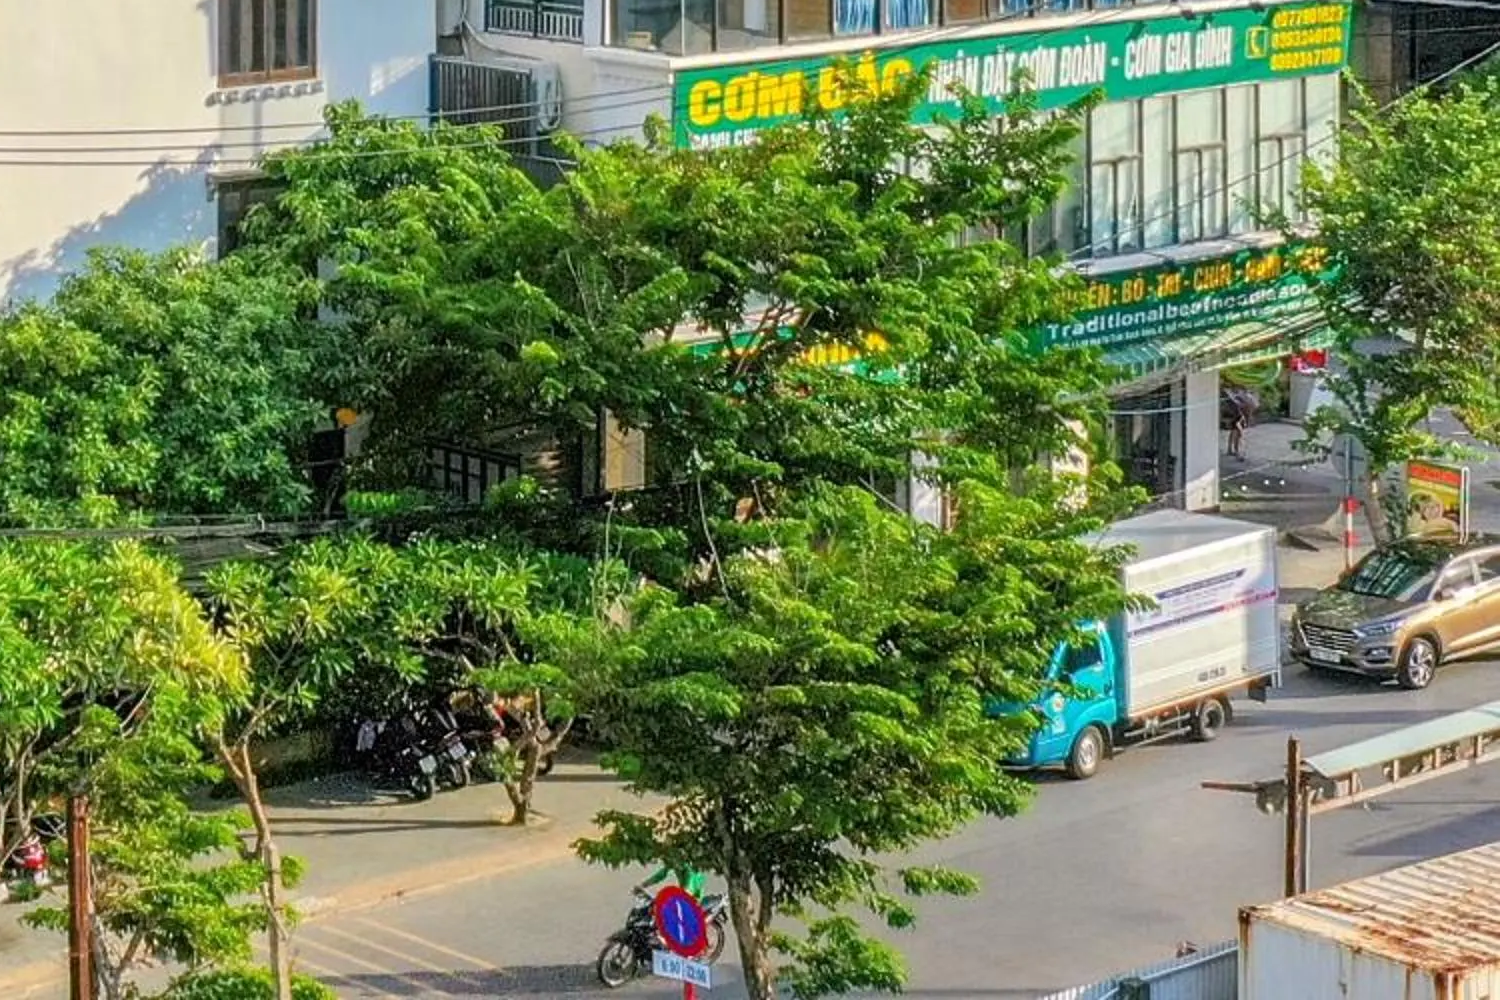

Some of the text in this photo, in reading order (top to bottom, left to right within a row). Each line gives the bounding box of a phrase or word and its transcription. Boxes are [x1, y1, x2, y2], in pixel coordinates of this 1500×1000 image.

[1059, 36, 1107, 87] ĐOÀN
[1124, 32, 1161, 80] CƠM
[1165, 30, 1192, 74] GIA
[1195, 24, 1234, 69] ĐÌNH
[689, 71, 805, 126] CƠM
[1048, 303, 1165, 340] Traditional
